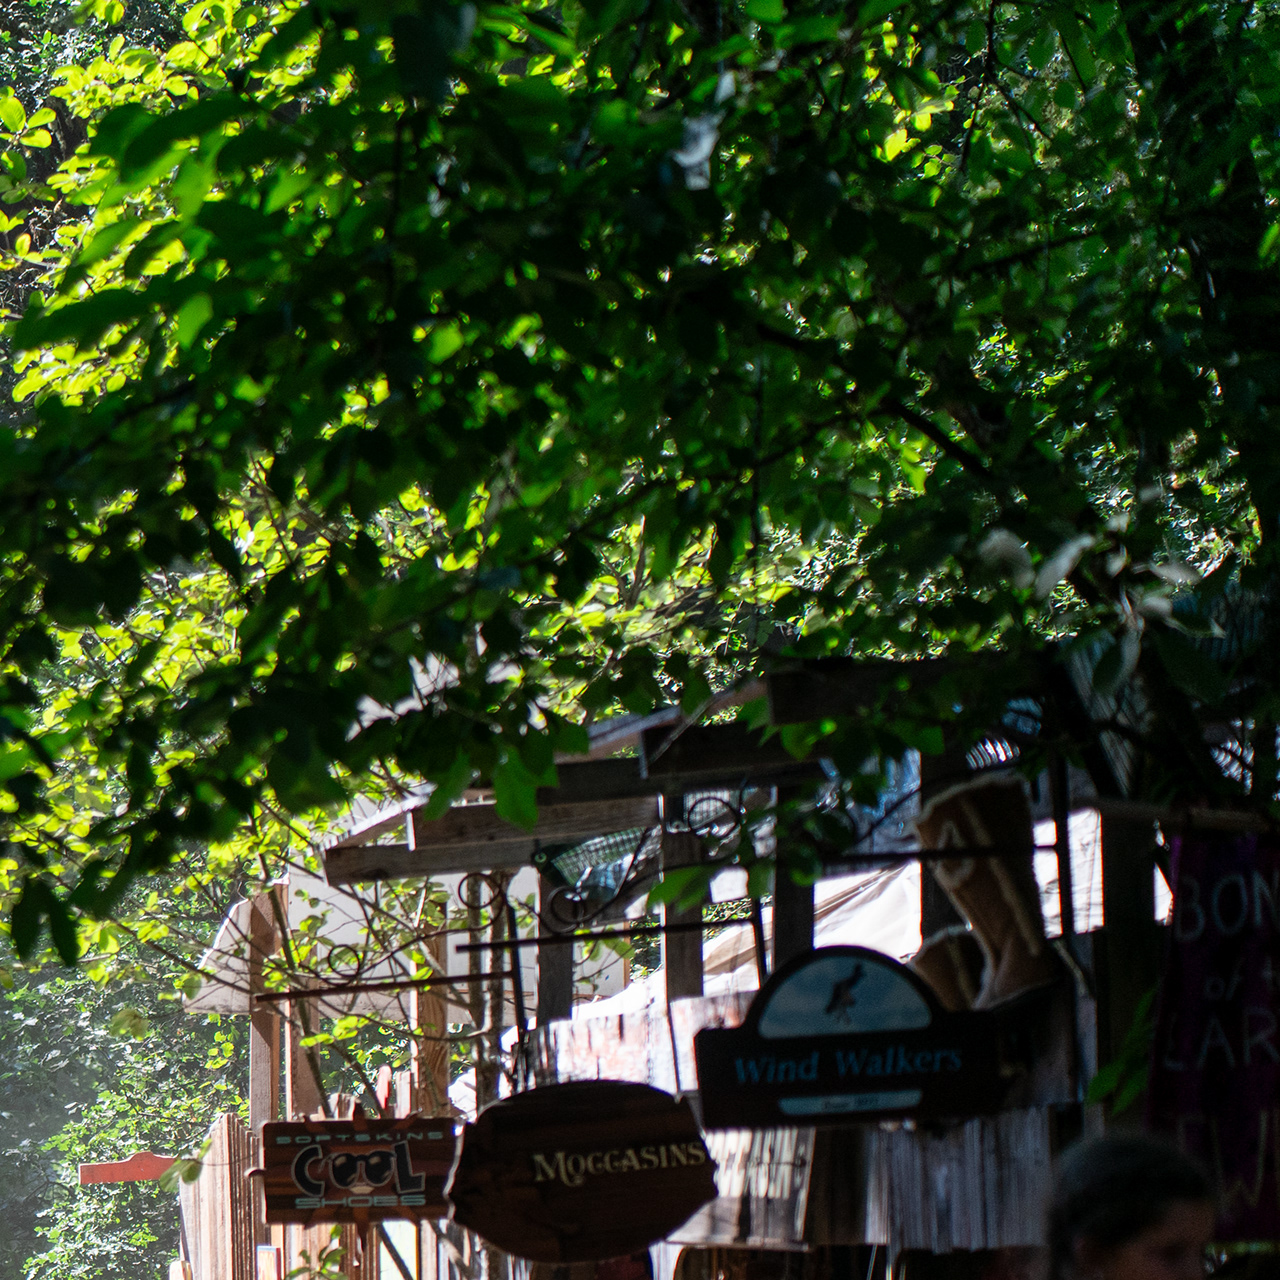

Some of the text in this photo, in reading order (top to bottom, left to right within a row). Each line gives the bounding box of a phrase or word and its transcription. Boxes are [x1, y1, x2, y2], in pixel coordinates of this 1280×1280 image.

[735, 1045, 962, 1083] Wind Walkers
[276, 1131, 444, 1145] SOFTSKINS
[294, 1194, 427, 1210] SHOES
